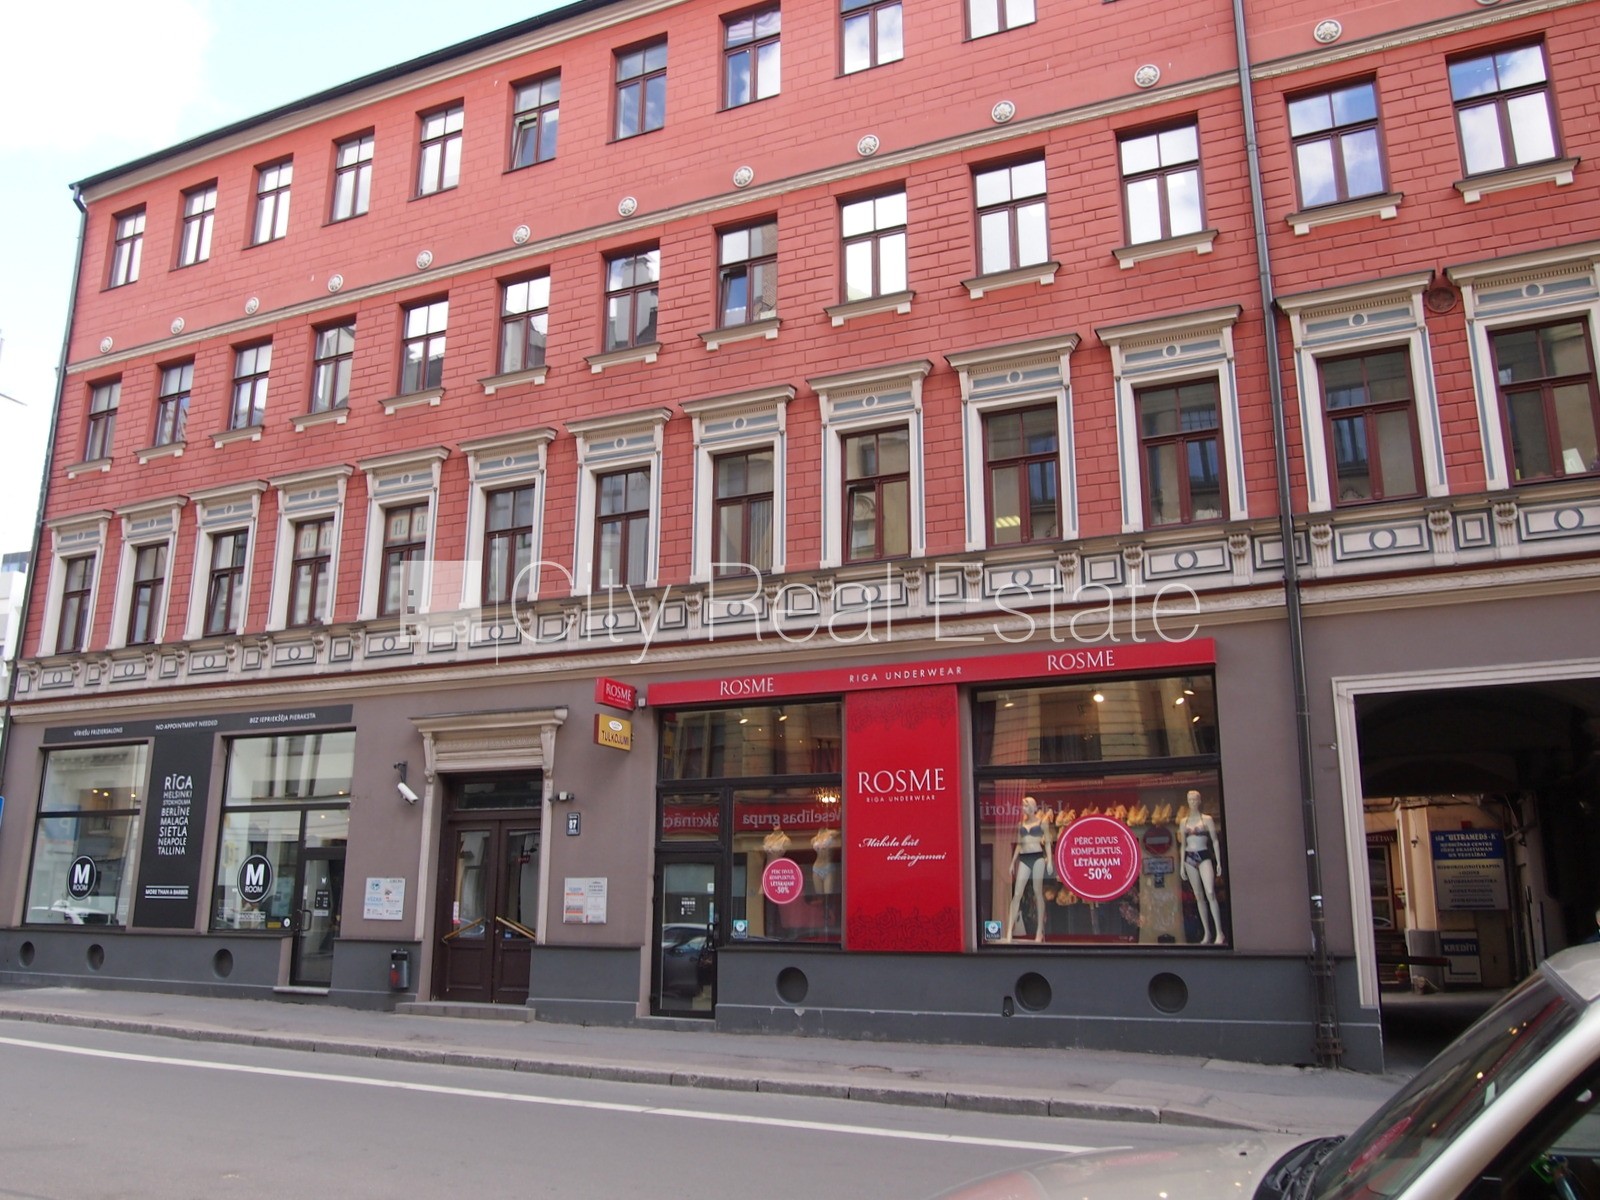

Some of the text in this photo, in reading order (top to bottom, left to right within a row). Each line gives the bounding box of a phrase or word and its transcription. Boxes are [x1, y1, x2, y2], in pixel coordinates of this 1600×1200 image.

[1047, 650, 1115, 671] ROSME
[849, 666, 962, 683] RIGA UNDERWEAR
[605, 682, 631, 702] ROSME
[720, 677, 774, 696] ROSME
[289, 712, 316, 720] PIERAKSTA
[164, 721, 198, 729] APPOINTMENT
[199, 719, 218, 727] NEEDED
[602, 730, 630, 745] TULKOJUMI
[164, 773, 193, 790] RĪGA
[858, 768, 946, 794] ROSME
[163, 790, 193, 799] HELSINKI
[161, 806, 190, 816] BERLĪNE
[160, 817, 189, 825] MALAGA
[159, 826, 188, 837] SIETLA
[157, 837, 187, 846] NEAPOLE
[859, 834, 919, 848] Māksla būt
[1074, 836, 1118, 845] PĒRC DIVUS
[158, 846, 186, 855] TALLINA
[1071, 846, 1123, 855] KOMPLEKTUS,
[887, 849, 947, 867] iekārojamai
[1073, 857, 1121, 868] LĒTĀKAJAM
[73, 863, 91, 884] M
[245, 863, 265, 886] M
[1084, 868, 1112, 880] -50%
[244, 885, 263, 893] ROOM
